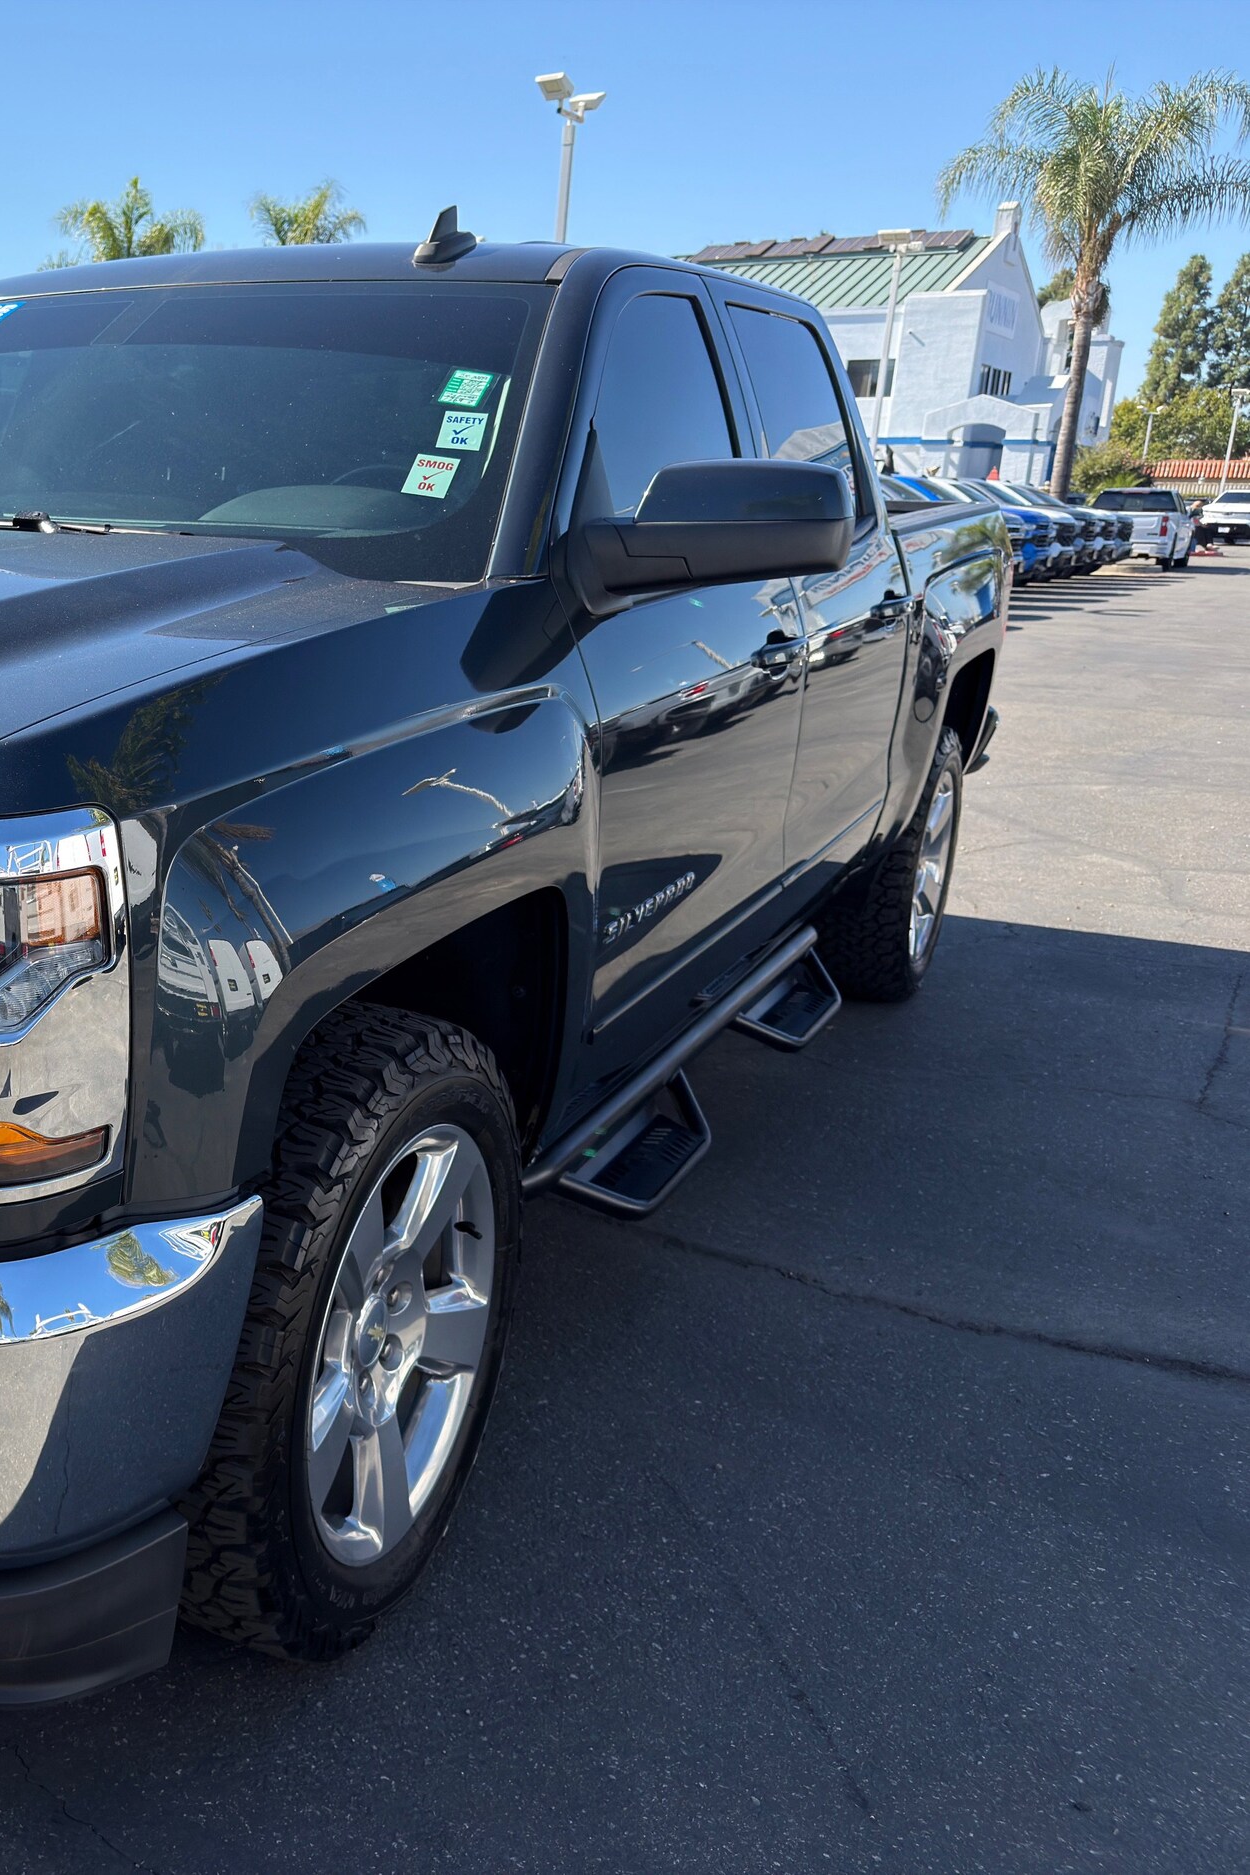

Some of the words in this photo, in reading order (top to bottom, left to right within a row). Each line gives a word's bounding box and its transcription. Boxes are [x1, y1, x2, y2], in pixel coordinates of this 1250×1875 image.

[446, 415, 485, 425] SAFETY
[450, 436, 469, 445] OK
[417, 459, 455, 471] SMOG
[417, 481, 436, 492] OK
[602, 871, 696, 944] SILVERADO
